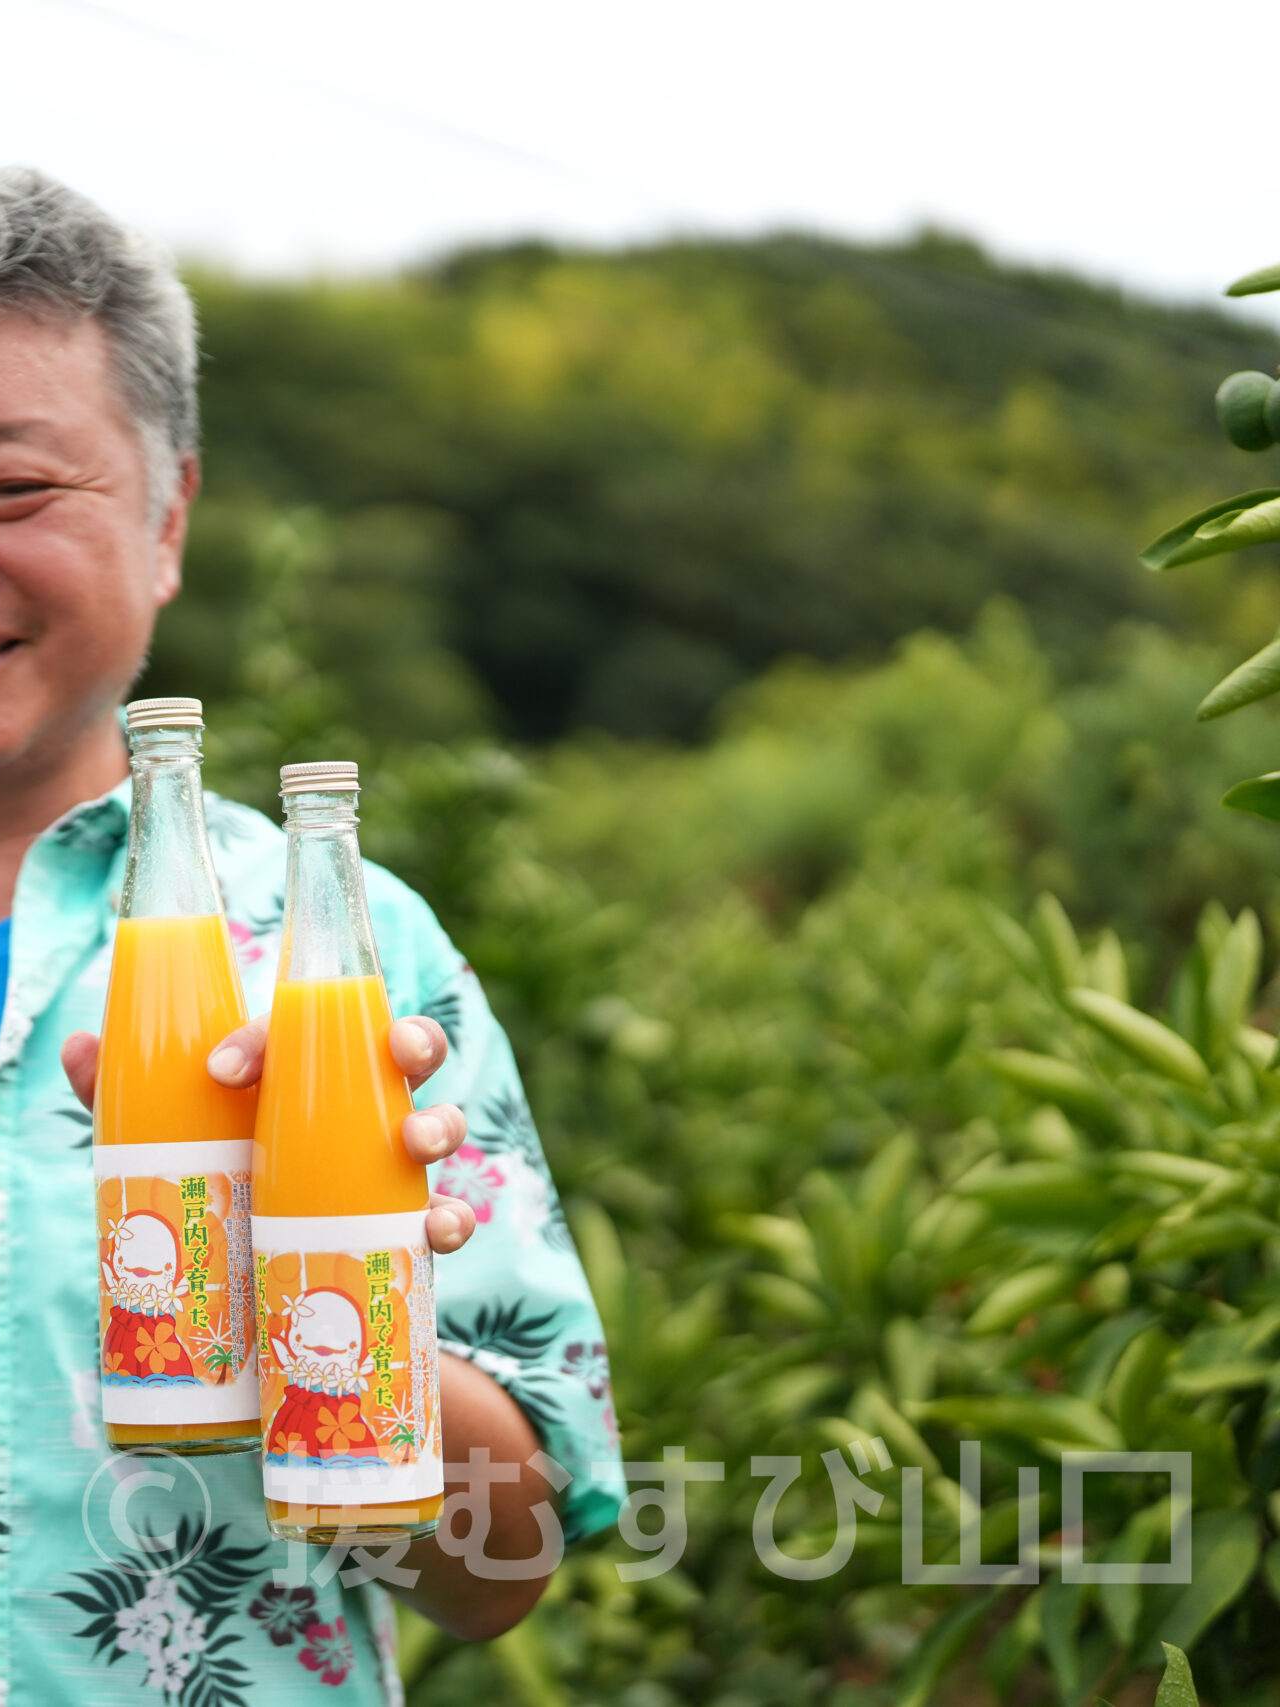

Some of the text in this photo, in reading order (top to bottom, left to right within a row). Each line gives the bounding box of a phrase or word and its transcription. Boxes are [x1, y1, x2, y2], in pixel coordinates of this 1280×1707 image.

[182, 1176, 208, 1328] 瀬戸内で育った
[366, 1252, 393, 1406] 瀬戸内で育った
